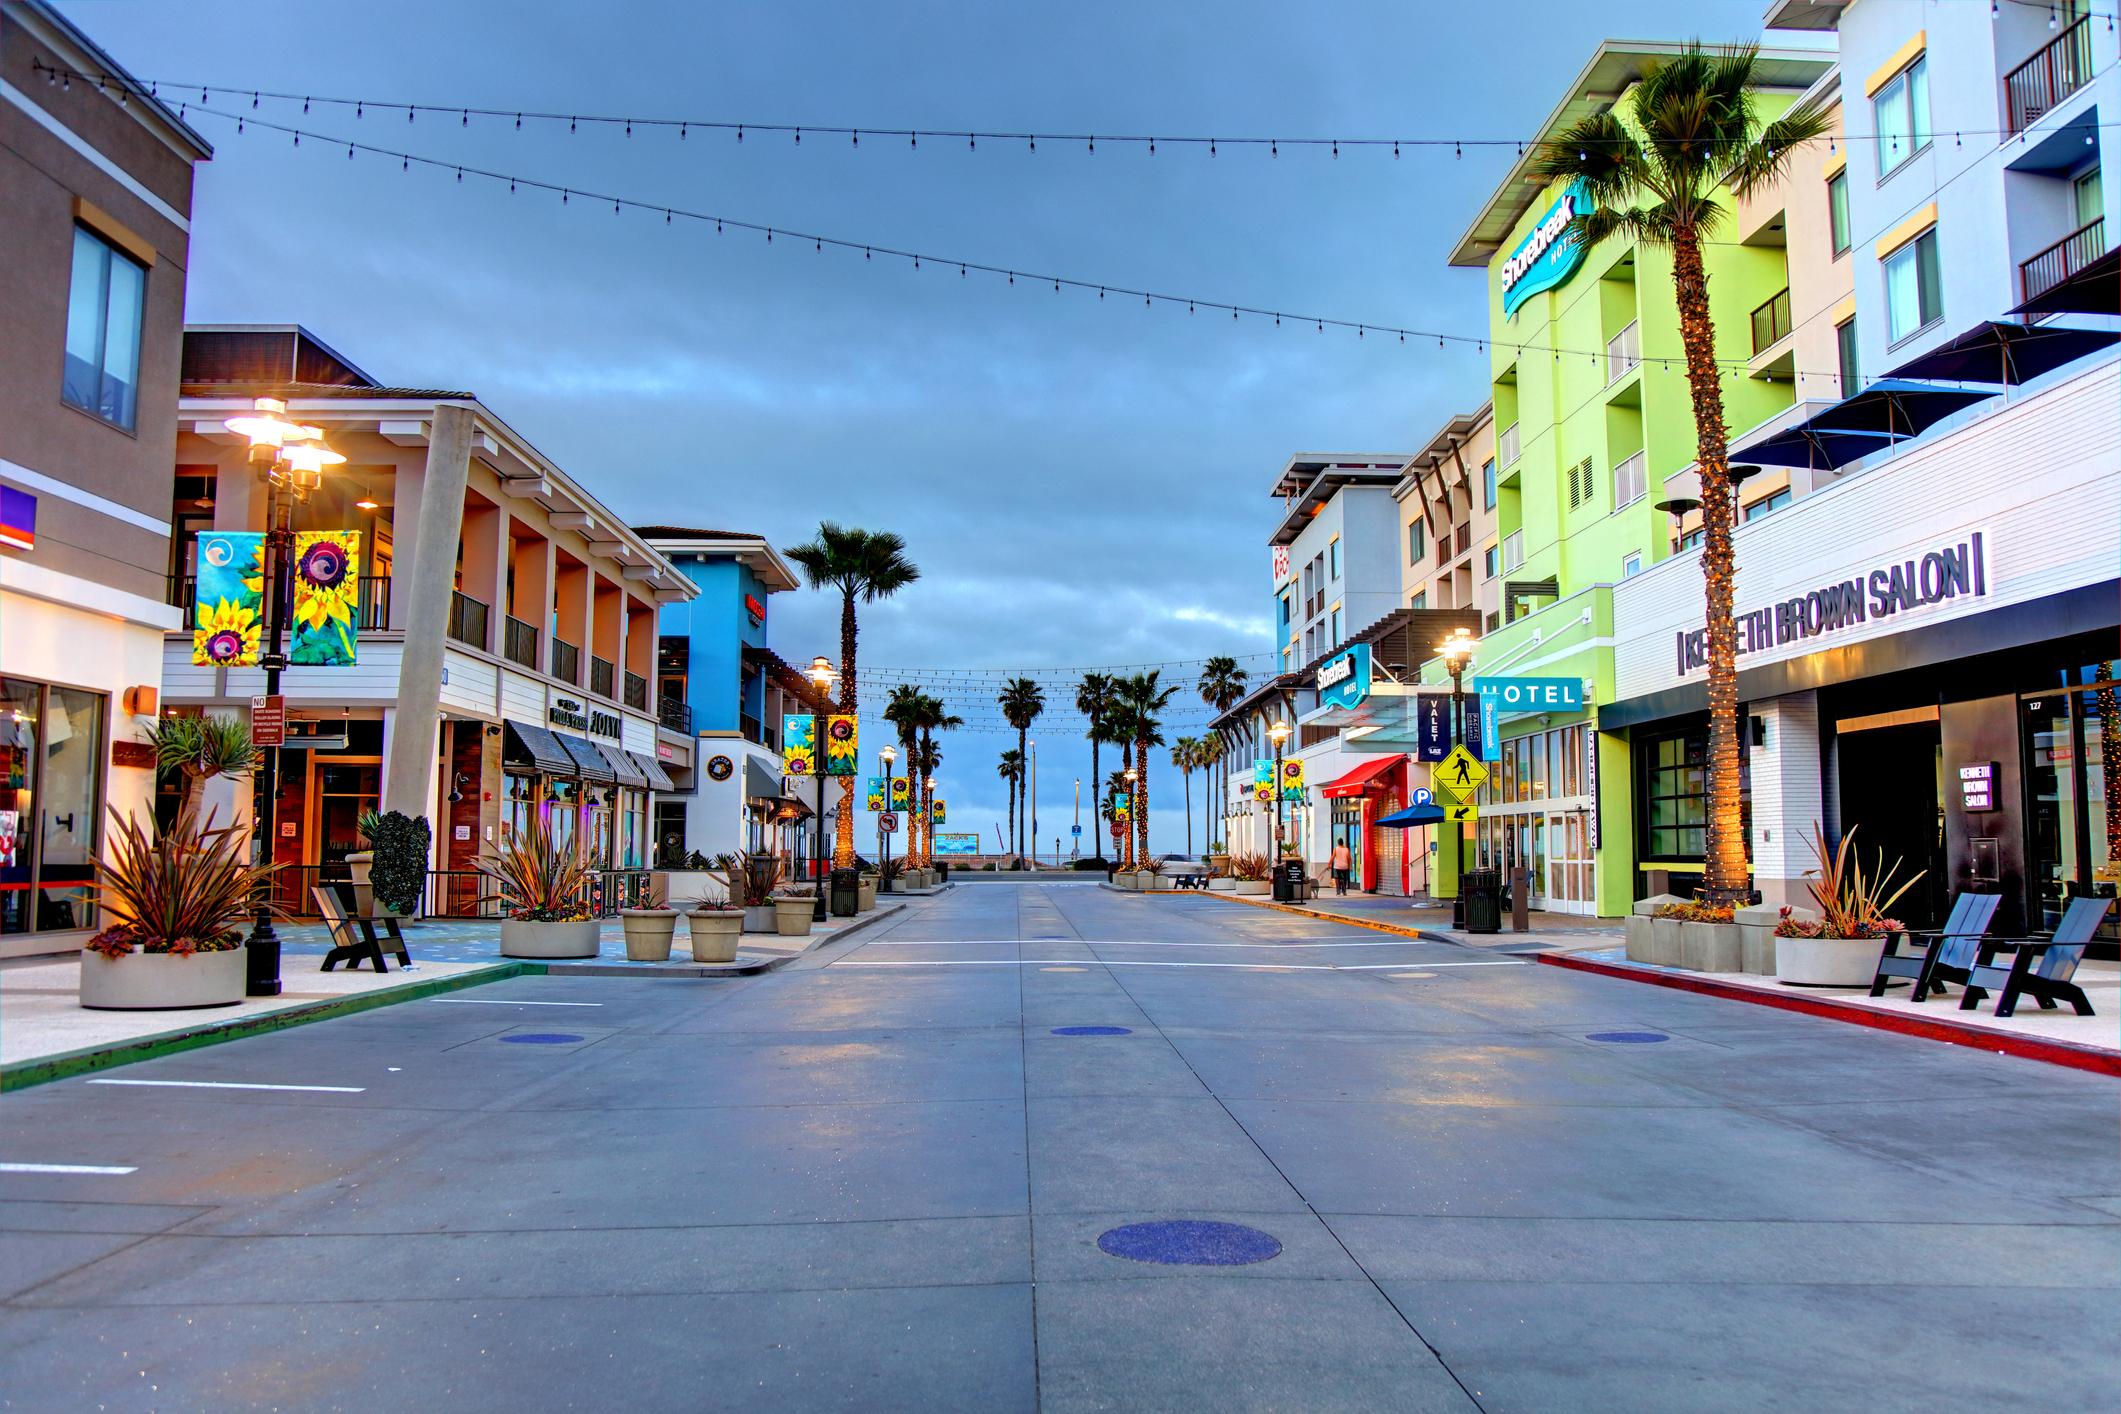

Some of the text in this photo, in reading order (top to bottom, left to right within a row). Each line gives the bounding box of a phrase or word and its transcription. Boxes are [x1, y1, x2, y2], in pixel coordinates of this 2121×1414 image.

[1502, 194, 1575, 292] Shorebreak
[1686, 543, 1971, 670] KEETH BROWN SALON
[254, 698, 264, 706] NO
[2030, 702, 2041, 710] 127
[1430, 700, 1438, 742] VALET
[1960, 765, 1991, 779] KENNETH
[1963, 780, 1989, 793] BROWN
[1417, 790, 1429, 804] P
[1965, 794, 1989, 807] SALON
[1112, 826, 1123, 834] STOP
